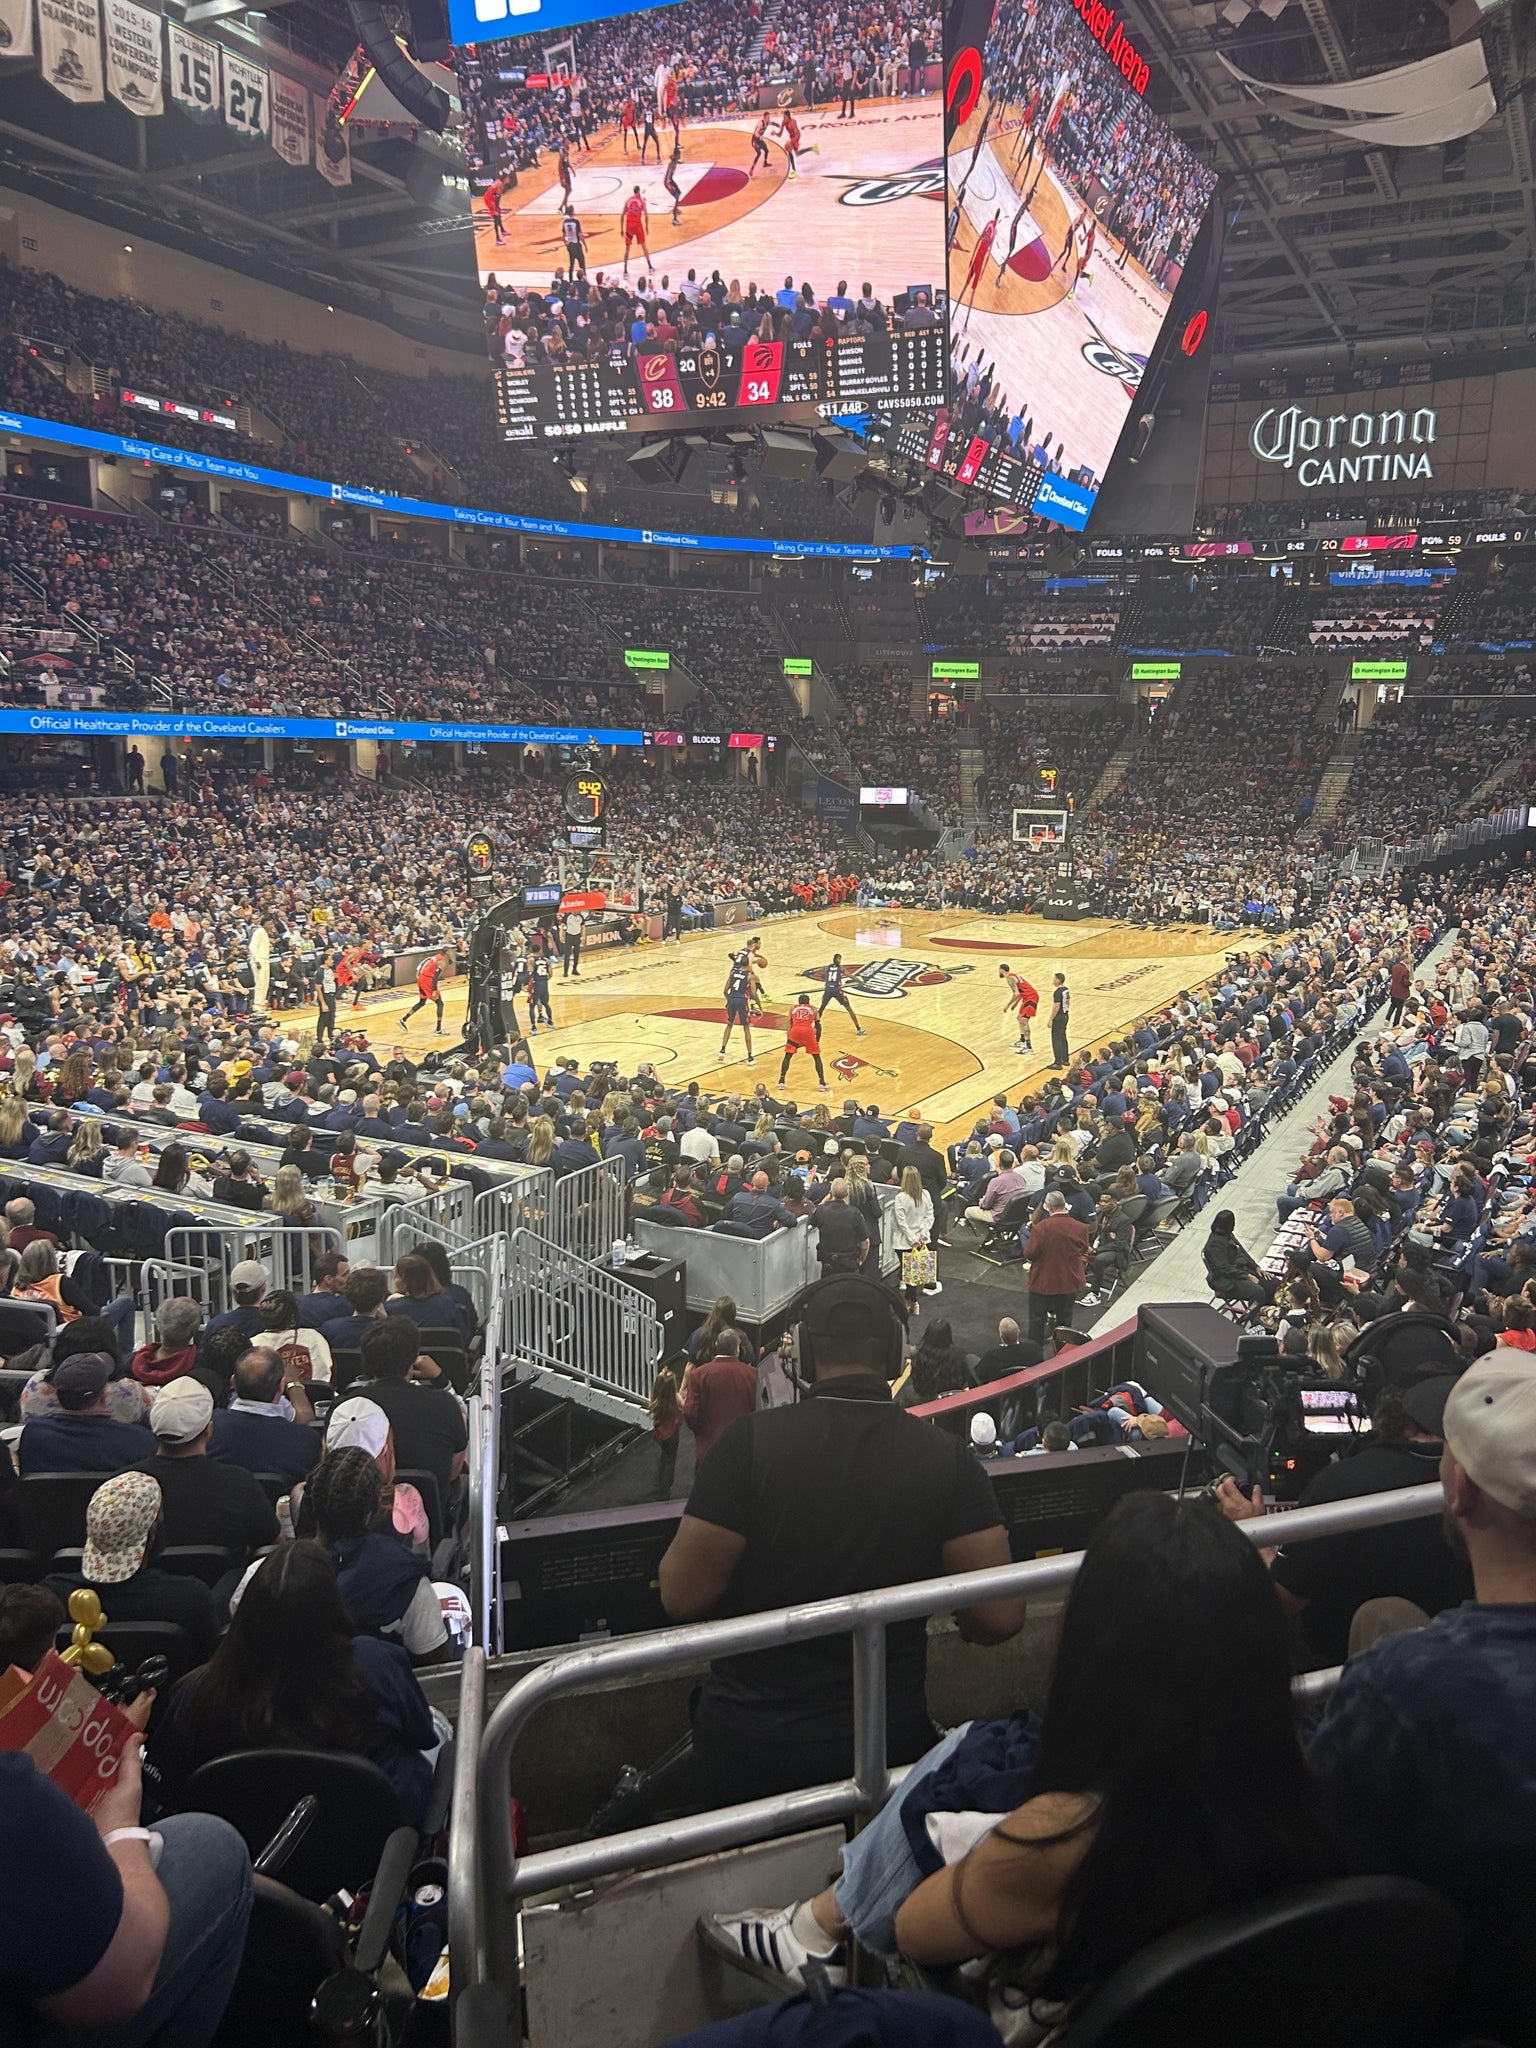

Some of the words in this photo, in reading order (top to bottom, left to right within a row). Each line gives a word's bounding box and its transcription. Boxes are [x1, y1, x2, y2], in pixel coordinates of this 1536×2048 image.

[41, 2, 97, 38] CHAMPIONS
[115, 23, 152, 51] WESTERN
[109, 36, 159, 69] CONFERENCE
[1073, 0, 1115, 47] cket
[1106, 22, 1150, 95] Arena
[112, 53, 158, 83] CHAMPIONS
[180, 53, 211, 105] 15
[230, 79, 262, 129] 27
[819, 117, 889, 130] Rocket
[838, 336, 865, 344] RAPTORS
[680, 360, 696, 372] 2Q
[725, 355, 733, 368] 7
[748, 381, 770, 401] 34
[651, 389, 674, 408] 38
[696, 392, 726, 408] 9:42
[818, 402, 862, 418] $11,448
[878, 395, 944, 410] CAVS5050.COM
[506, 424, 533, 437] oswald
[584, 420, 628, 433] RAFFLE
[1249, 404, 1438, 469] Corona
[121, 439, 150, 460] Taking
[151, 446, 173, 463] Care
[174, 452, 183, 464] of
[184, 454, 204, 469] Your
[204, 459, 227, 474] Team
[227, 464, 243, 477] and
[244, 466, 259, 480] You
[929, 447, 941, 465] 38
[962, 463, 974, 479] 34
[1298, 452, 1434, 487] CANTINA
[342, 489, 369, 503] Cleveland
[369, 494, 384, 506] Clinic
[1050, 490, 1074, 510] Cleveland
[1073, 500, 1088, 515] Clinic
[454, 508, 476, 524] Taking
[477, 513, 494, 524] Care
[495, 516, 503, 525] of
[504, 516, 519, 528] Your
[520, 518, 538, 530] Team
[539, 522, 552, 532] and
[554, 523, 567, 534] You
[652, 534, 680, 544] Cleveland
[681, 536, 698, 546] Clinic
[1355, 539, 1368, 548] 34
[1421, 536, 1443, 545] FG%
[1448, 535, 1461, 544] 59
[1476, 533, 1506, 543] FOULS
[1514, 531, 1521, 541] 0
[772, 542, 795, 554] Taking
[796, 544, 814, 554] Care
[816, 544, 823, 554] of
[824, 545, 841, 555] Your
[843, 546, 862, 555] Team
[863, 547, 877, 555] and
[1168, 547, 1180, 556] 55
[1226, 544, 1238, 554] 38
[1261, 544, 1267, 552] 7
[1287, 542, 1305, 551] 9:42
[1322, 540, 1338, 550] 2Q
[632, 656, 656, 665] Huntington
[1361, 667, 1391, 675] Huntington
[30, 716, 71, 731] Official
[74, 717, 130, 732] Healthcare
[132, 719, 170, 732] Provider
[174, 720, 184, 732] of
[185, 720, 201, 732] the
[203, 720, 246, 734] Cleveland
[248, 721, 285, 734] Cavaliers
[348, 724, 376, 734] Cleveland
[378, 725, 395, 736] Clinic
[429, 727, 452, 738] Official
[454, 728, 486, 739] Healthcare
[487, 730, 510, 740] Provider
[511, 730, 518, 740] of
[518, 730, 528, 740] the
[529, 730, 554, 741] Cleveland
[555, 731, 578, 742] Cavaliers
[677, 735, 682, 744] 0
[692, 736, 720, 744] BLOCKS
[587, 795, 599, 818] 7
[818, 796, 855, 807] LECOM
[480, 856, 486, 868] 7
[586, 933, 602, 946] EM
[536, 965, 548, 976] 45
[828, 972, 838, 982] 14
[732, 978, 741, 990] 4
[796, 1010, 809, 1020] 12
